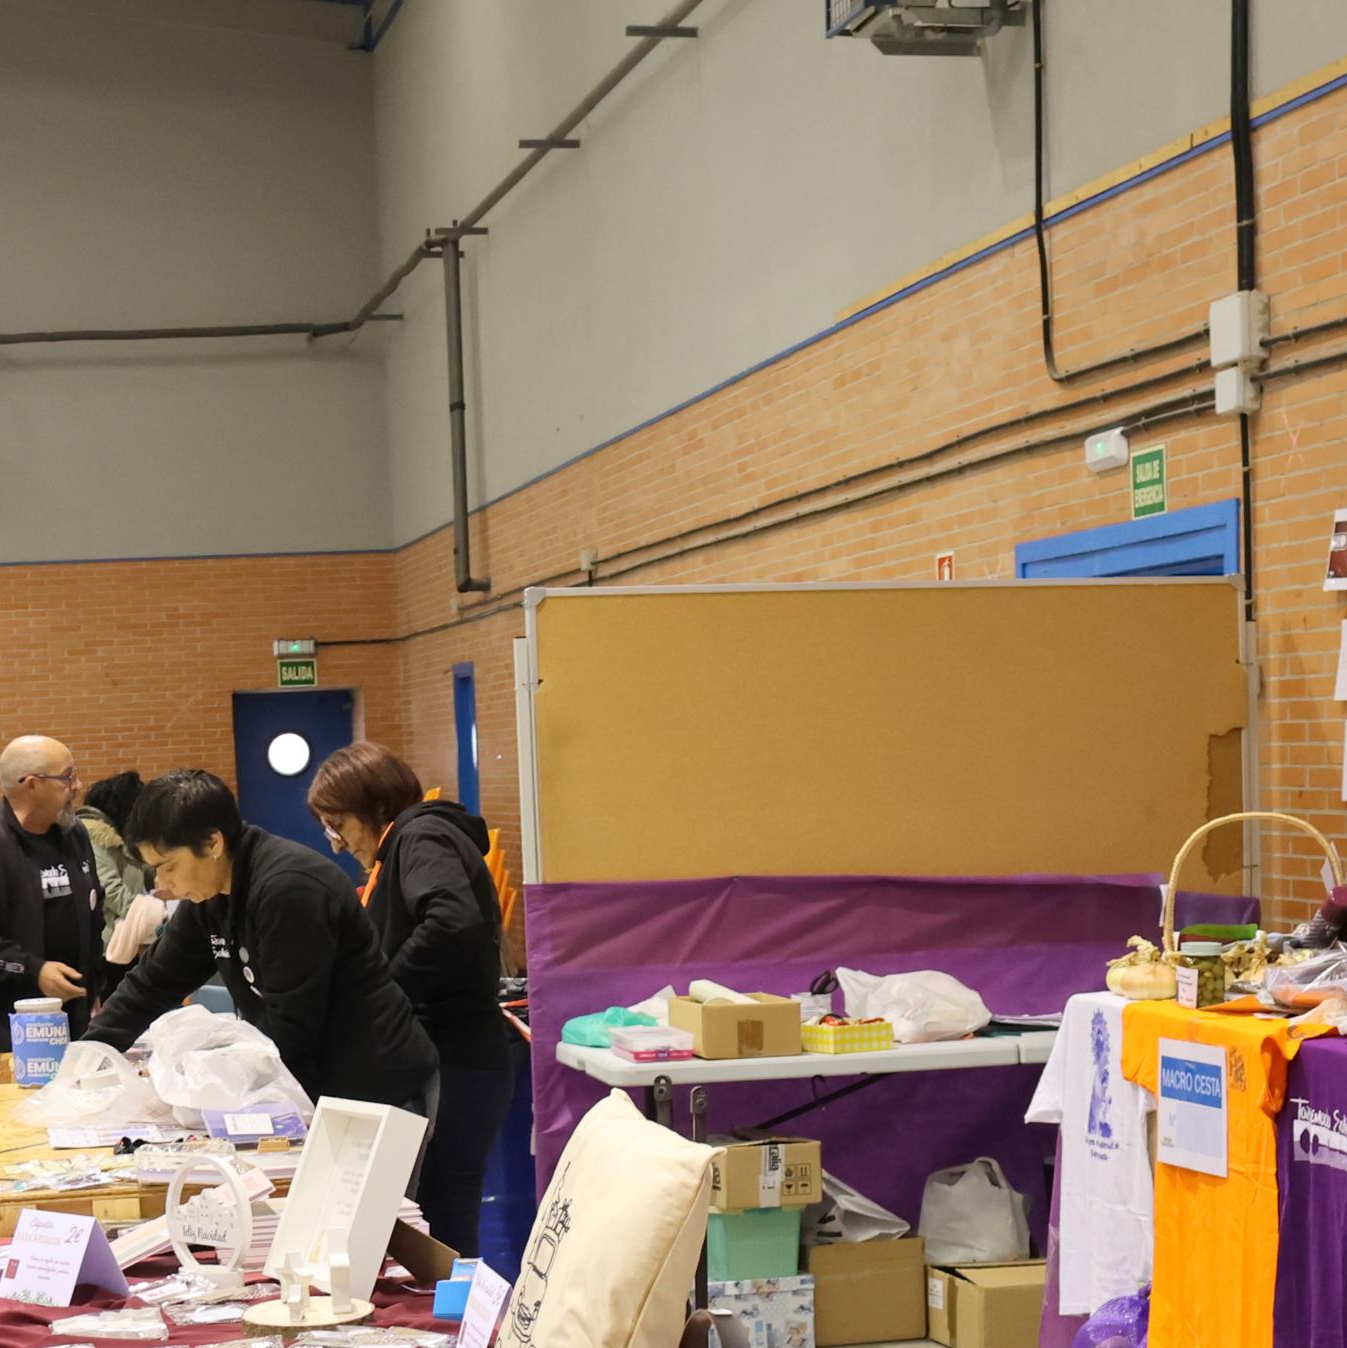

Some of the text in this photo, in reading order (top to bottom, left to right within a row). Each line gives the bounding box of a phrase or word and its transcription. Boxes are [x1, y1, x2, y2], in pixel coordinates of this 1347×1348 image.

[282, 666, 314, 681] SALIDA
[25, 1023, 68, 1038] EMUNÁ
[1162, 1068, 1222, 1098] MACRO CESTA
[197, 1225, 228, 1243] Navidad
